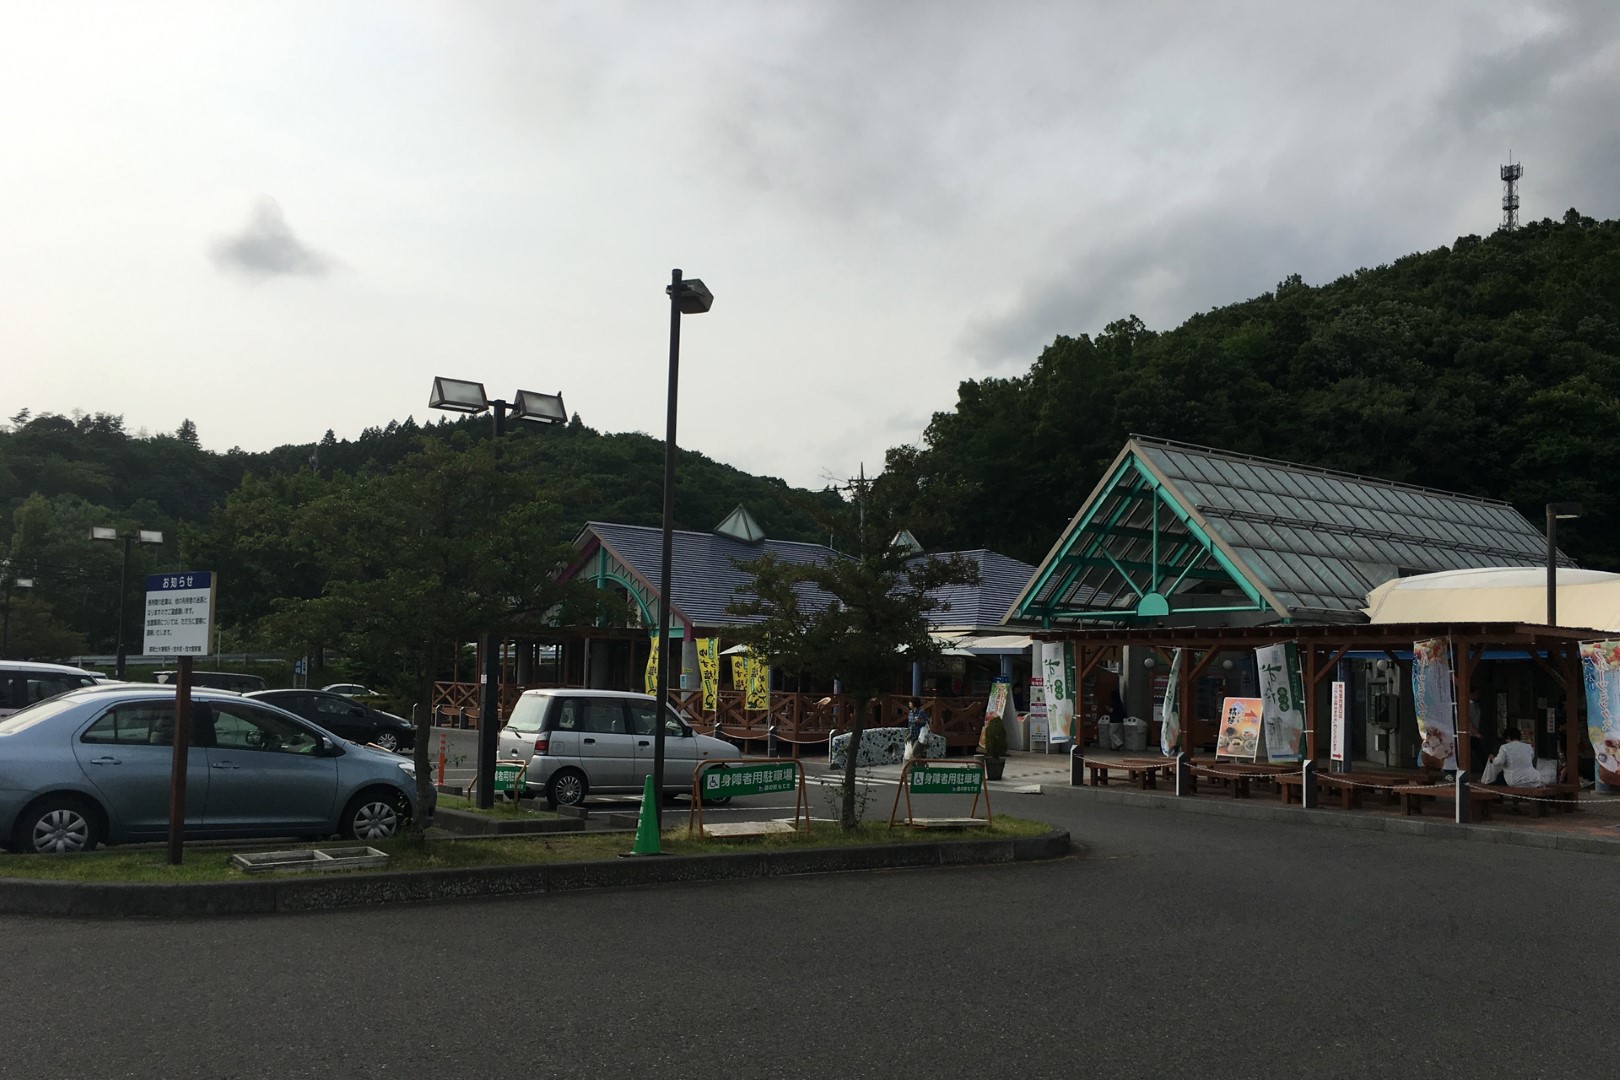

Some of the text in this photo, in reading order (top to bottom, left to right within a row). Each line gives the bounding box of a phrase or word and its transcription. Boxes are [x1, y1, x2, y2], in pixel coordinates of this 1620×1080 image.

[162, 576, 194, 589] お知らせ
[721, 768, 793, 787] 身障者用駐車場
[924, 772, 981, 785] 身障者用駐車場
